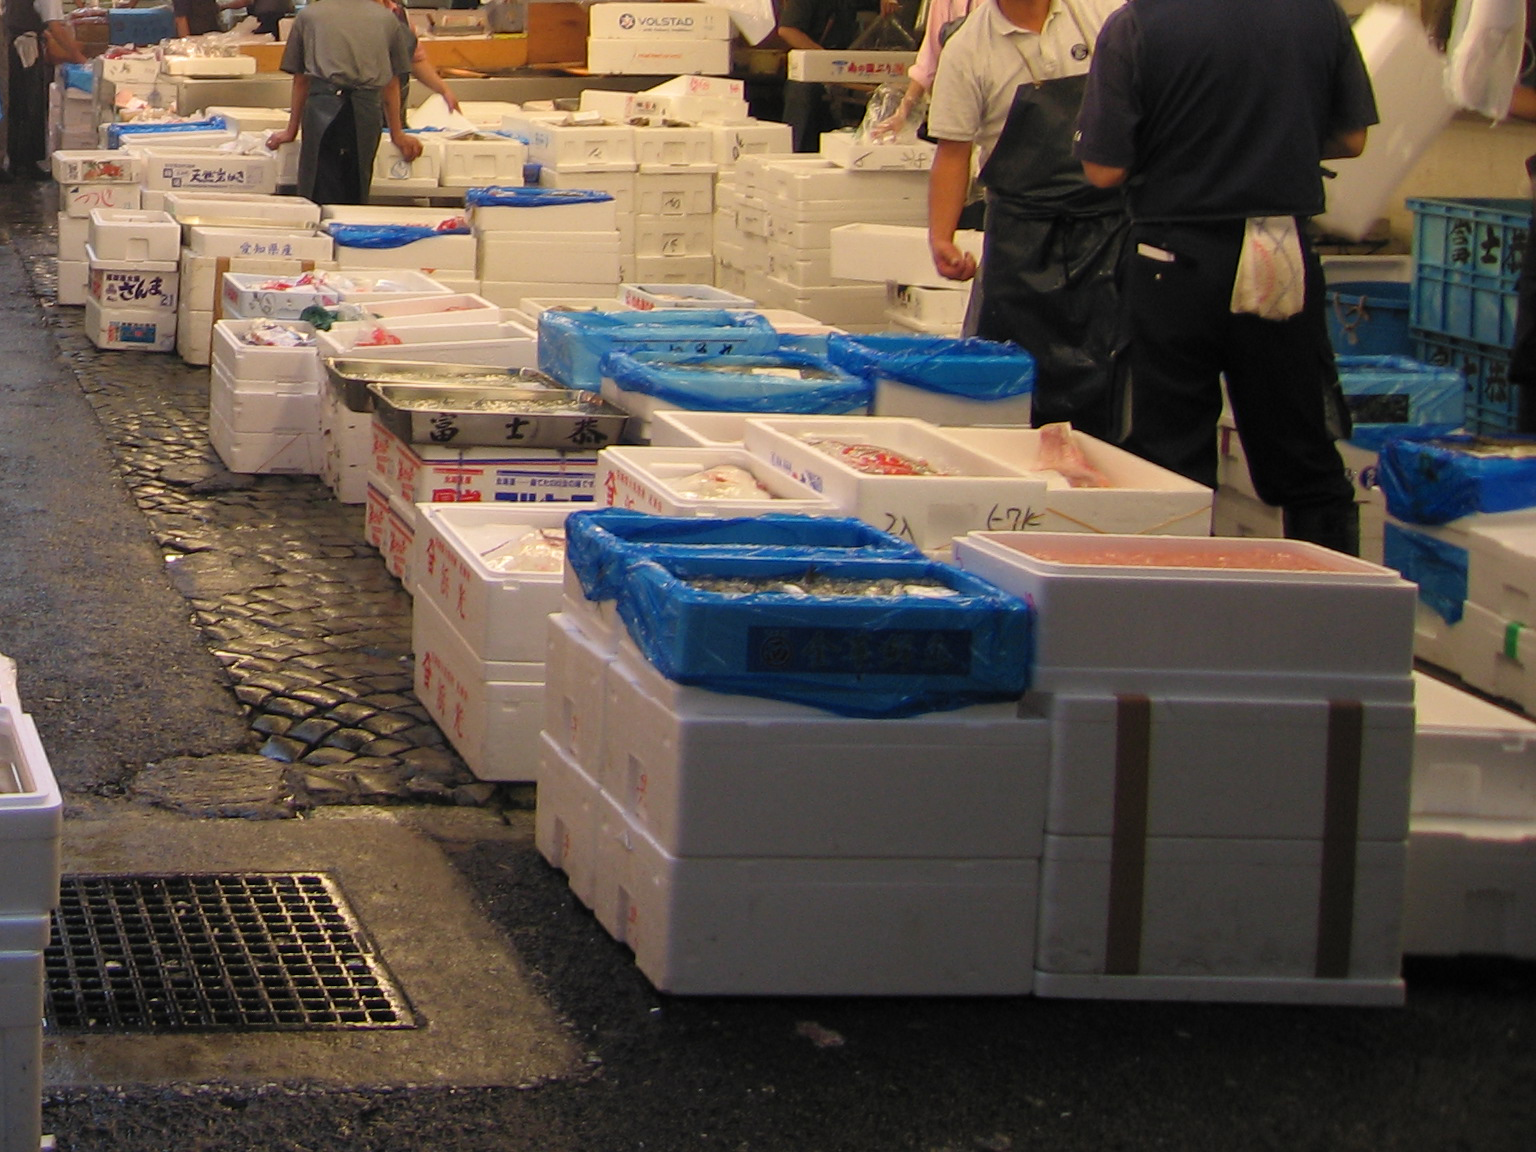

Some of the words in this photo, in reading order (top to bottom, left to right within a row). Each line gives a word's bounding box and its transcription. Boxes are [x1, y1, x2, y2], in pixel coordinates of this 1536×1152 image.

[637, 16, 695, 27] VOLSTAD
[117, 275, 164, 302] さんま
[429, 413, 609, 444] 富士恭
